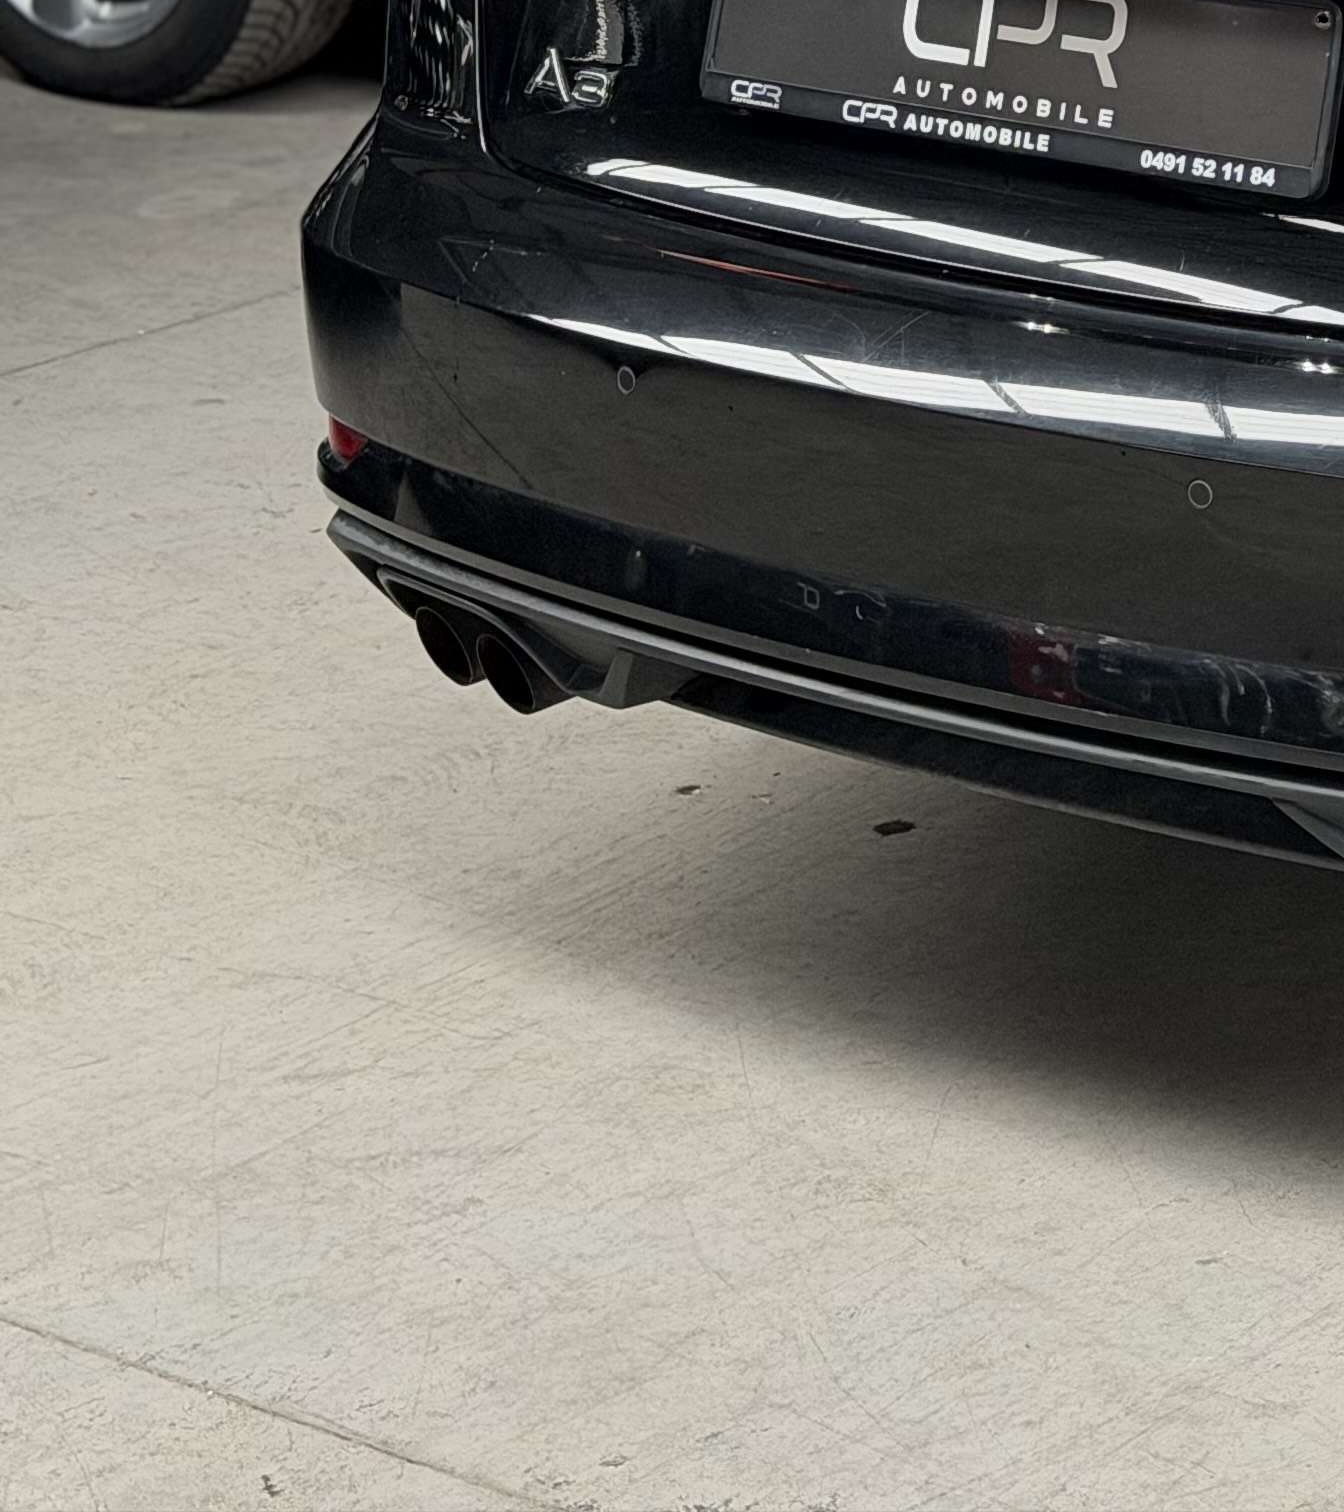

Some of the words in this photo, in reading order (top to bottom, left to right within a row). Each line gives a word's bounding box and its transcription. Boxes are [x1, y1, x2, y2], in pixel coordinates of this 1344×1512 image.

[524, 47, 608, 107] A3
[731, 80, 783, 102] CPR
[893, 76, 1115, 129] AUTOMOBILE
[842, 100, 898, 128] CPR
[904, 114, 1050, 152] AUTOMOBILE
[1140, 150, 1187, 174] 0491
[1192, 157, 1217, 178] 52
[1222, 162, 1245, 183] 11
[1250, 166, 1276, 187] 84
